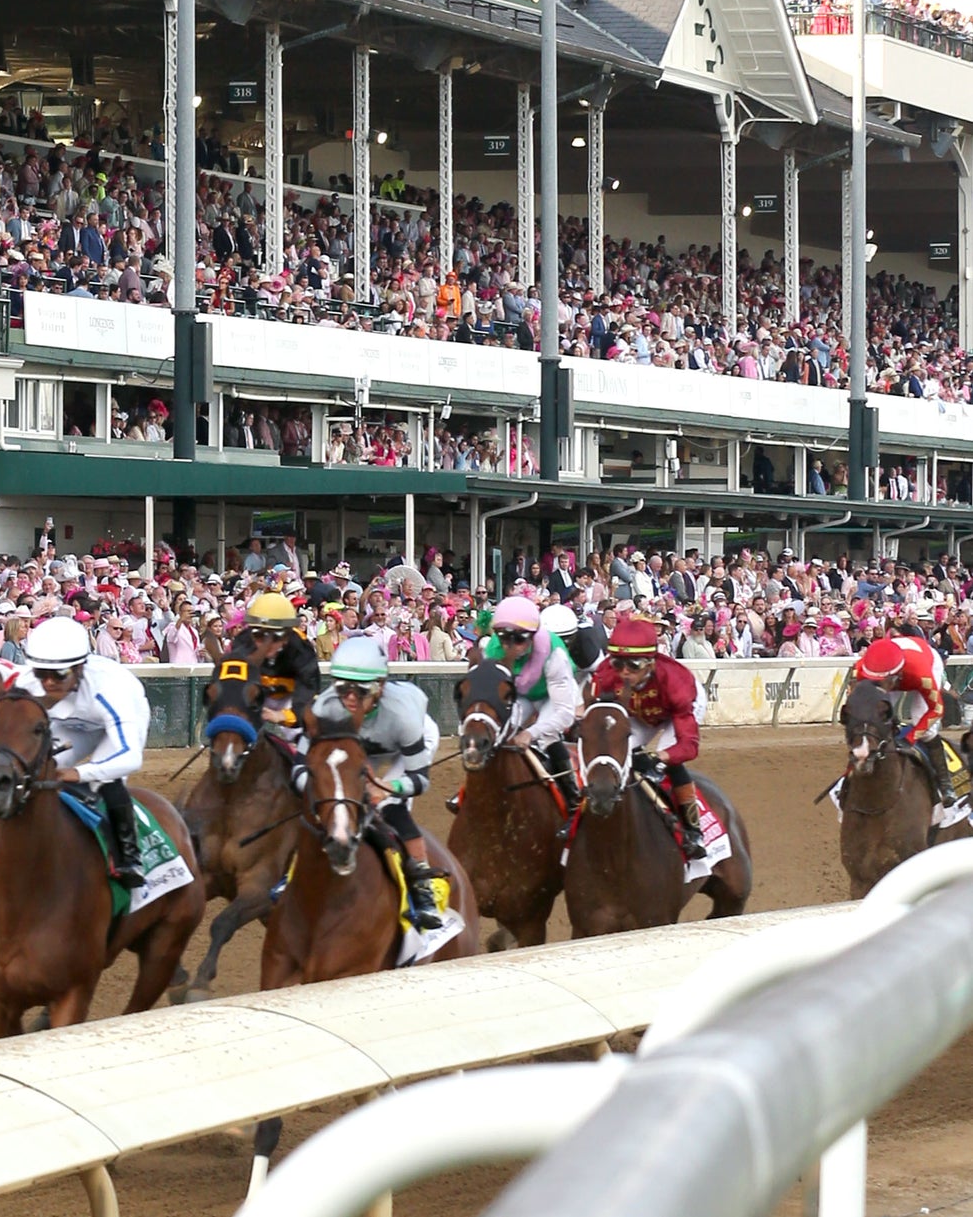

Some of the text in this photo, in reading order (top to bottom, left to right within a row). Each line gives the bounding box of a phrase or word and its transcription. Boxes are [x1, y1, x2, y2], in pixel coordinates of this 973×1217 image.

[234, 87, 252, 97] 318
[488, 141, 505, 150] 319
[758, 199, 773, 208] 319
[933, 247, 948, 255] 320
